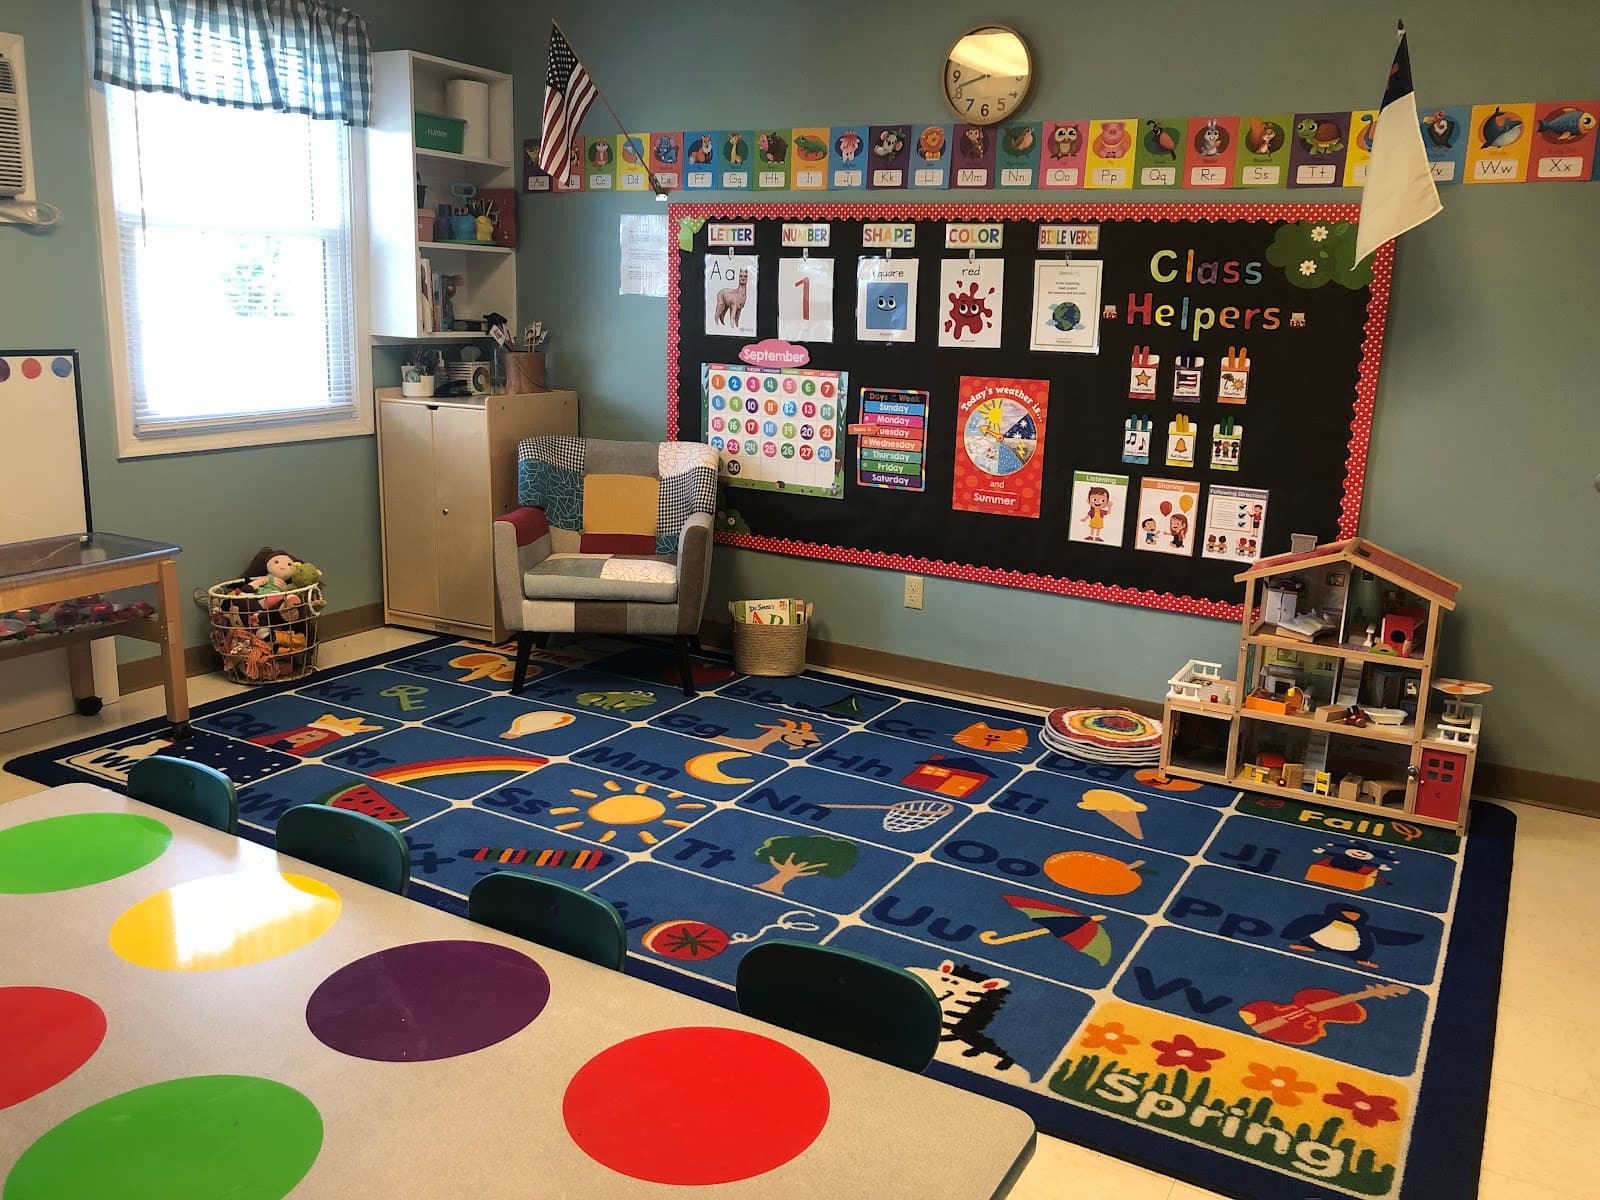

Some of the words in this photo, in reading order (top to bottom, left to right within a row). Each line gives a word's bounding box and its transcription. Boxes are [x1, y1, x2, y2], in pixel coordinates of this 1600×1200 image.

[953, 69, 962, 83] 9
[955, 86, 963, 99] 8
[966, 98, 975, 112] 7
[980, 103, 989, 117] 6
[997, 98, 1005, 111] 5
[1480, 160, 1513, 174] Ww
[1548, 158, 1572, 172] Xx
[627, 174, 639, 185] Dd
[694, 173, 704, 184] Ff
[765, 173, 779, 184] Hh
[843, 172, 853, 187] Jj
[881, 171, 894, 182] Kk
[924, 171, 934, 182] Ll
[962, 171, 983, 182] Mm
[1008, 171, 1025, 182] Nn
[1054, 170, 1070, 182] Oo
[1101, 169, 1117, 185] Pp
[1149, 169, 1167, 185] Qq
[1200, 169, 1216, 181] Rr
[1254, 167, 1269, 180] Ss
[1308, 166, 1326, 179] Tt
[595, 175, 606, 185] Cc
[729, 173, 742, 189] Gg
[710, 228, 752, 242] LETTER
[783, 228, 828, 242] NUMBER
[864, 228, 912, 243] SHAPE
[949, 228, 1000, 243] COLOR
[1040, 229, 1067, 245] BIBLE
[1070, 230, 1097, 245] VERSE
[962, 265, 981, 276] red
[1150, 249, 1262, 285] Class
[794, 276, 810, 320] 1
[1127, 293, 1281, 342] Helpers
[744, 348, 805, 363] September
[870, 392, 888, 401] Days
[961, 386, 993, 412] Today's
[996, 386, 1033, 407] weather
[747, 401, 755, 410] 10
[785, 403, 794, 413] 12
[804, 405, 813, 414] 13
[880, 403, 909, 413] Sunday
[877, 416, 910, 426] Monday
[713, 420, 721, 429] 15
[730, 421, 737, 430] 16
[747, 422, 755, 431] 17
[784, 426, 792, 435] 19
[802, 428, 812, 437] 20
[822, 429, 831, 438] 21
[877, 428, 909, 438] uesday
[713, 440, 723, 448] 22
[728, 442, 738, 451] 23
[746, 443, 756, 452] 24
[765, 444, 775, 454] 25
[783, 446, 793, 456] 26
[801, 448, 811, 457] 27
[820, 449, 830, 458] 28
[869, 438, 915, 451] Wednesday
[873, 450, 910, 461] Thursday
[729, 463, 739, 472] 30
[877, 462, 904, 473] Friday
[872, 474, 909, 485] Saturday
[990, 480, 1005, 489] and
[1086, 475, 1117, 485] Listening
[1157, 482, 1185, 492] Sharing
[1209, 488, 1238, 498] Following
[1238, 491, 1267, 500] Directions
[973, 492, 1017, 506] Summer
[433, 711, 487, 729] Ll
[659, 713, 730, 739] Gg
[874, 719, 936, 742] Cc
[334, 746, 396, 769] Rr
[583, 746, 680, 781] Mm
[806, 749, 893, 779] Hh
[482, 786, 551, 815] Ss
[745, 787, 832, 822] Nn
[991, 789, 1049, 815] Ii
[1298, 808, 1386, 837] Fall
[673, 837, 737, 869] Tt
[943, 839, 1041, 877] Oo
[1220, 843, 1281, 873] Jj
[872, 895, 977, 942] Uu
[1170, 896, 1274, 938] Pp
[1133, 966, 1234, 1014] Vv
